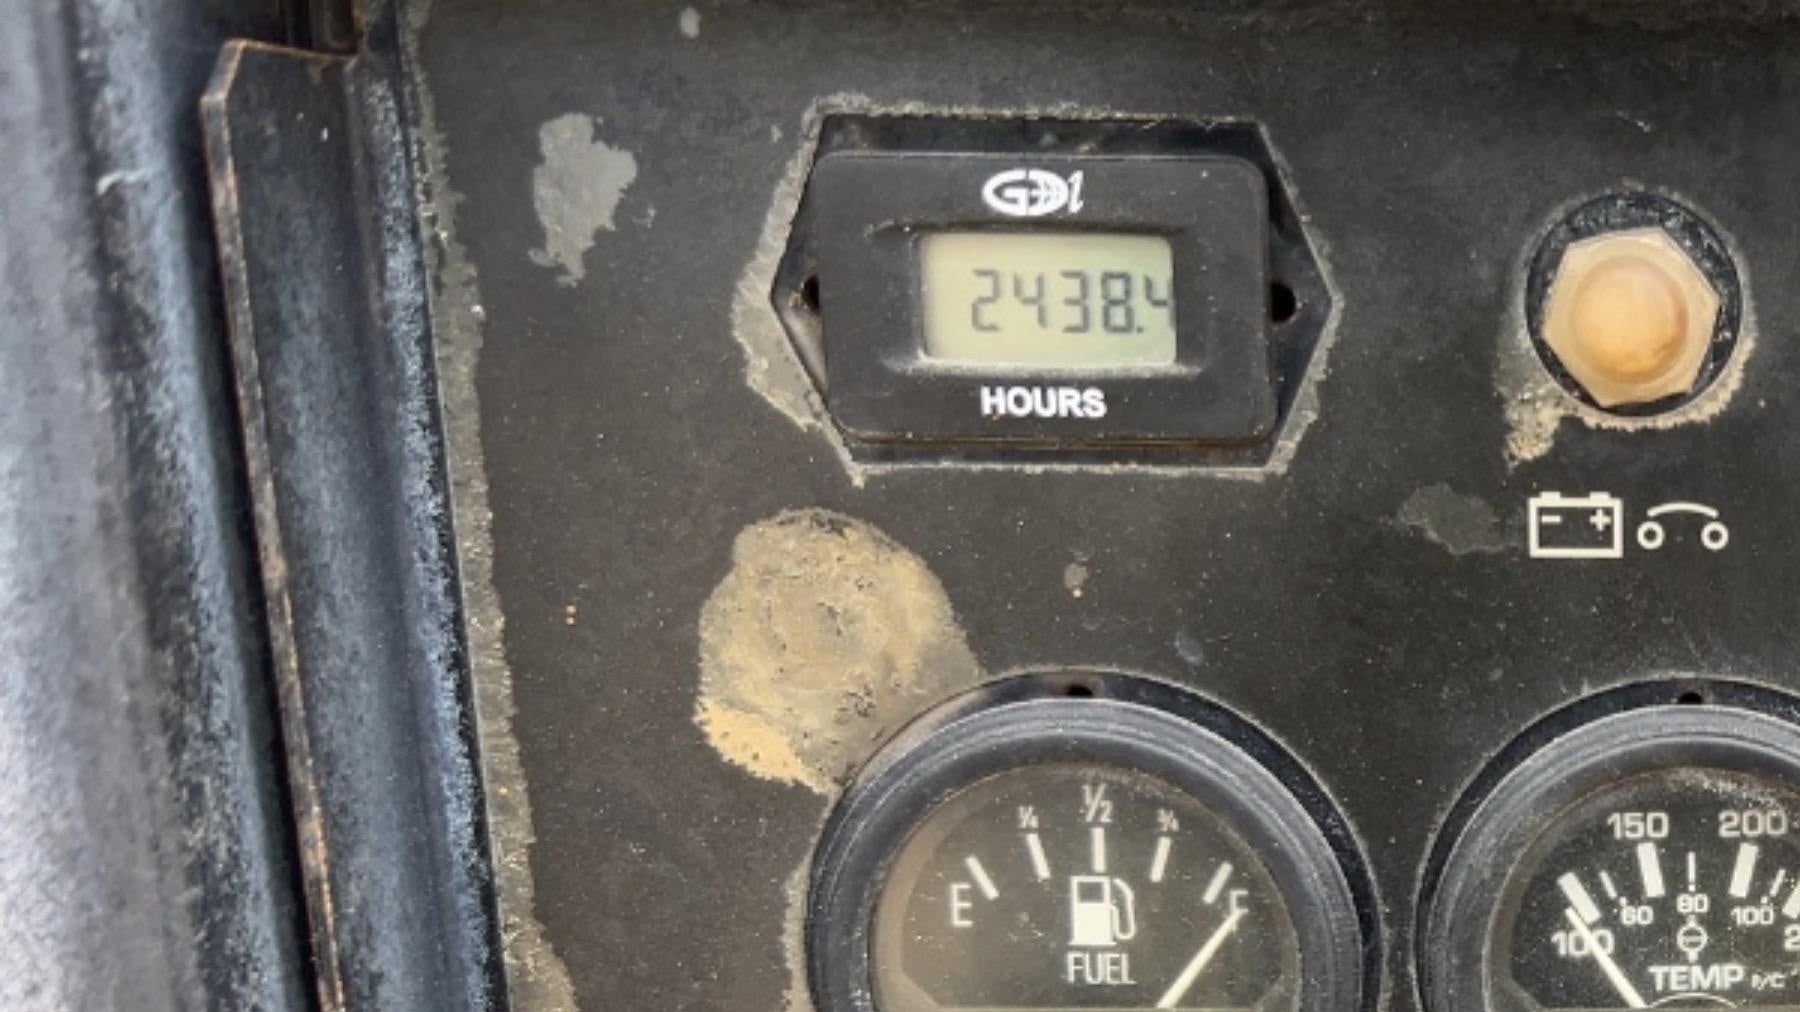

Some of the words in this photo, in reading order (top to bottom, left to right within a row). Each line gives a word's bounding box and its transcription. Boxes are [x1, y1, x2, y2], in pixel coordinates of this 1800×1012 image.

[980, 385, 1107, 418] HOURS
[1606, 811, 1670, 840] 150
[1718, 810, 1788, 839] 200
[949, 882, 974, 928] E
[1676, 893, 1709, 914] 80
[1731, 906, 1774, 926] 100
[1550, 929, 1615, 958] 100
[1067, 952, 1136, 985] FUEL
[1648, 964, 1745, 992] TEMP
